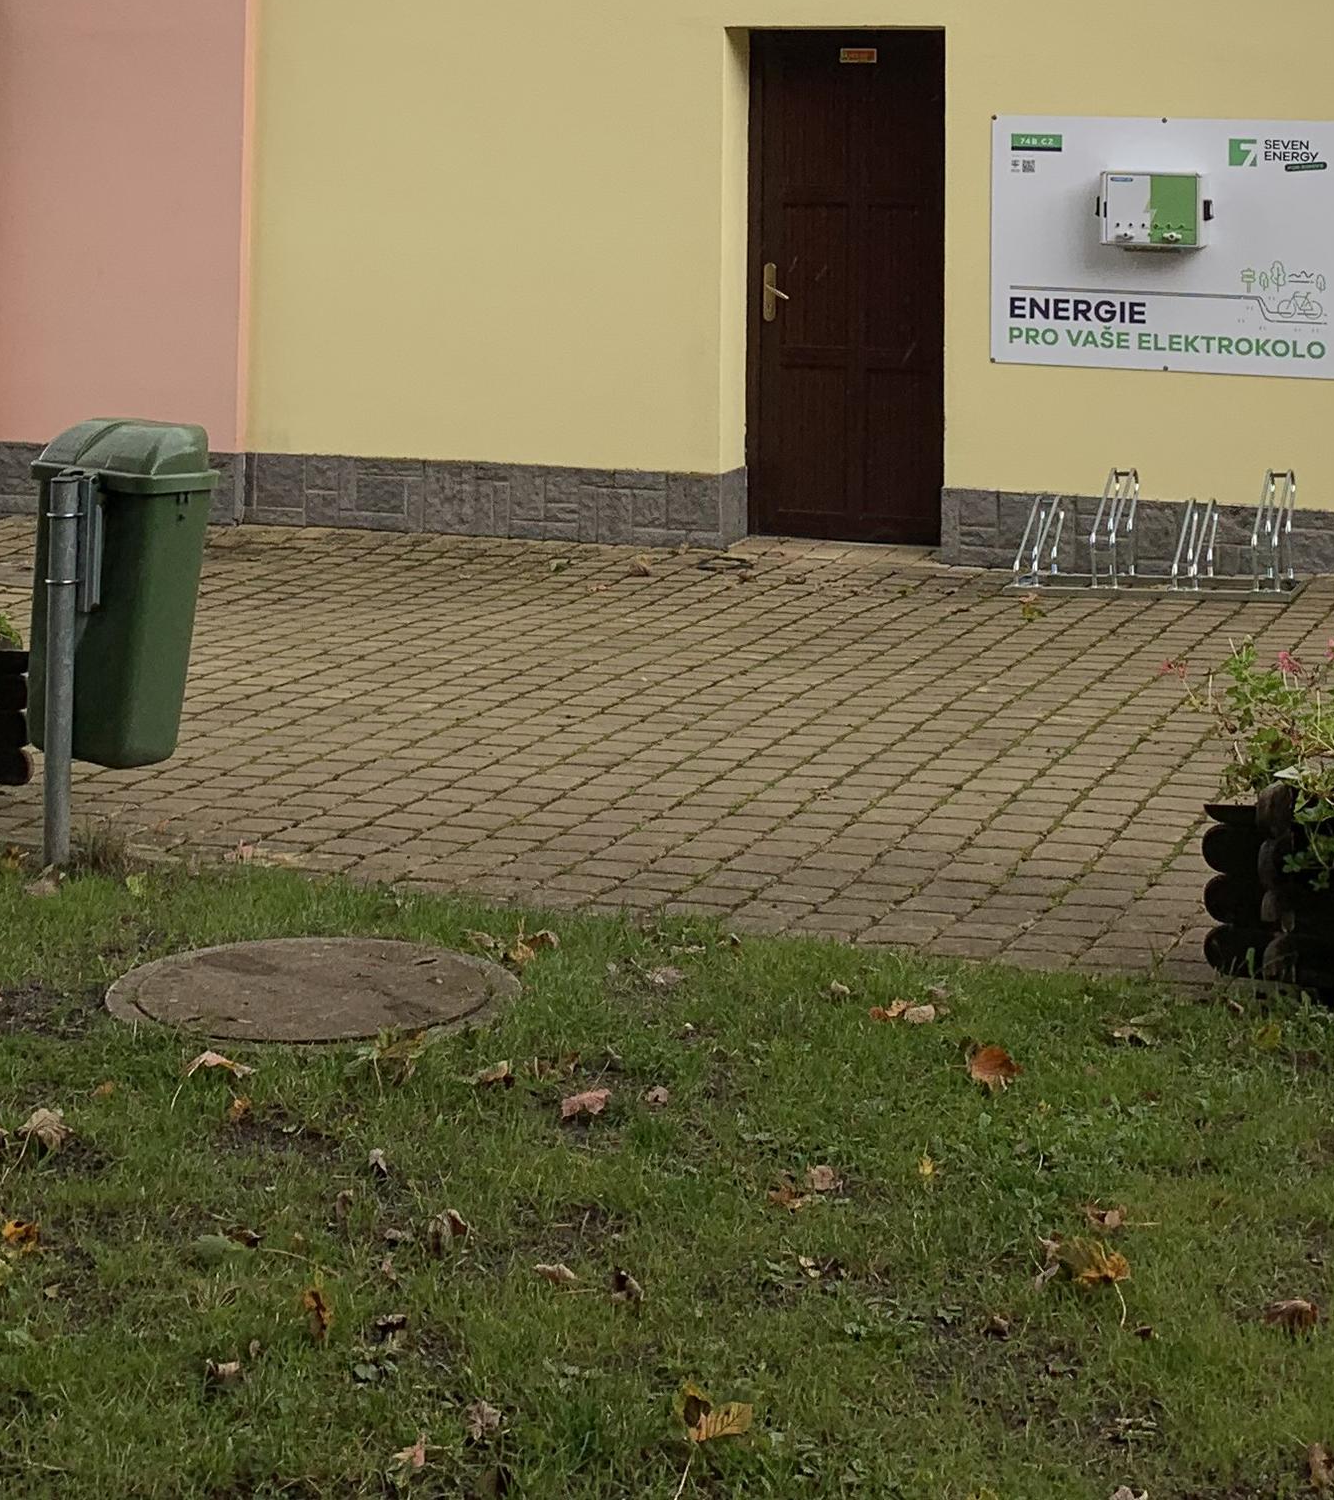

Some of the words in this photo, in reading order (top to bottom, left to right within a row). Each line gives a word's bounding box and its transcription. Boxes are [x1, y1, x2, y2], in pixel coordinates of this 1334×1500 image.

[1264, 139, 1310, 151] SEVEN
[1263, 150, 1319, 163] ENERGY
[1009, 296, 1147, 325] ENERGIE
[1008, 326, 1059, 346] PRO
[1065, 324, 1131, 350] VAŠE
[1137, 332, 1327, 361] ELEKTROKOLO
